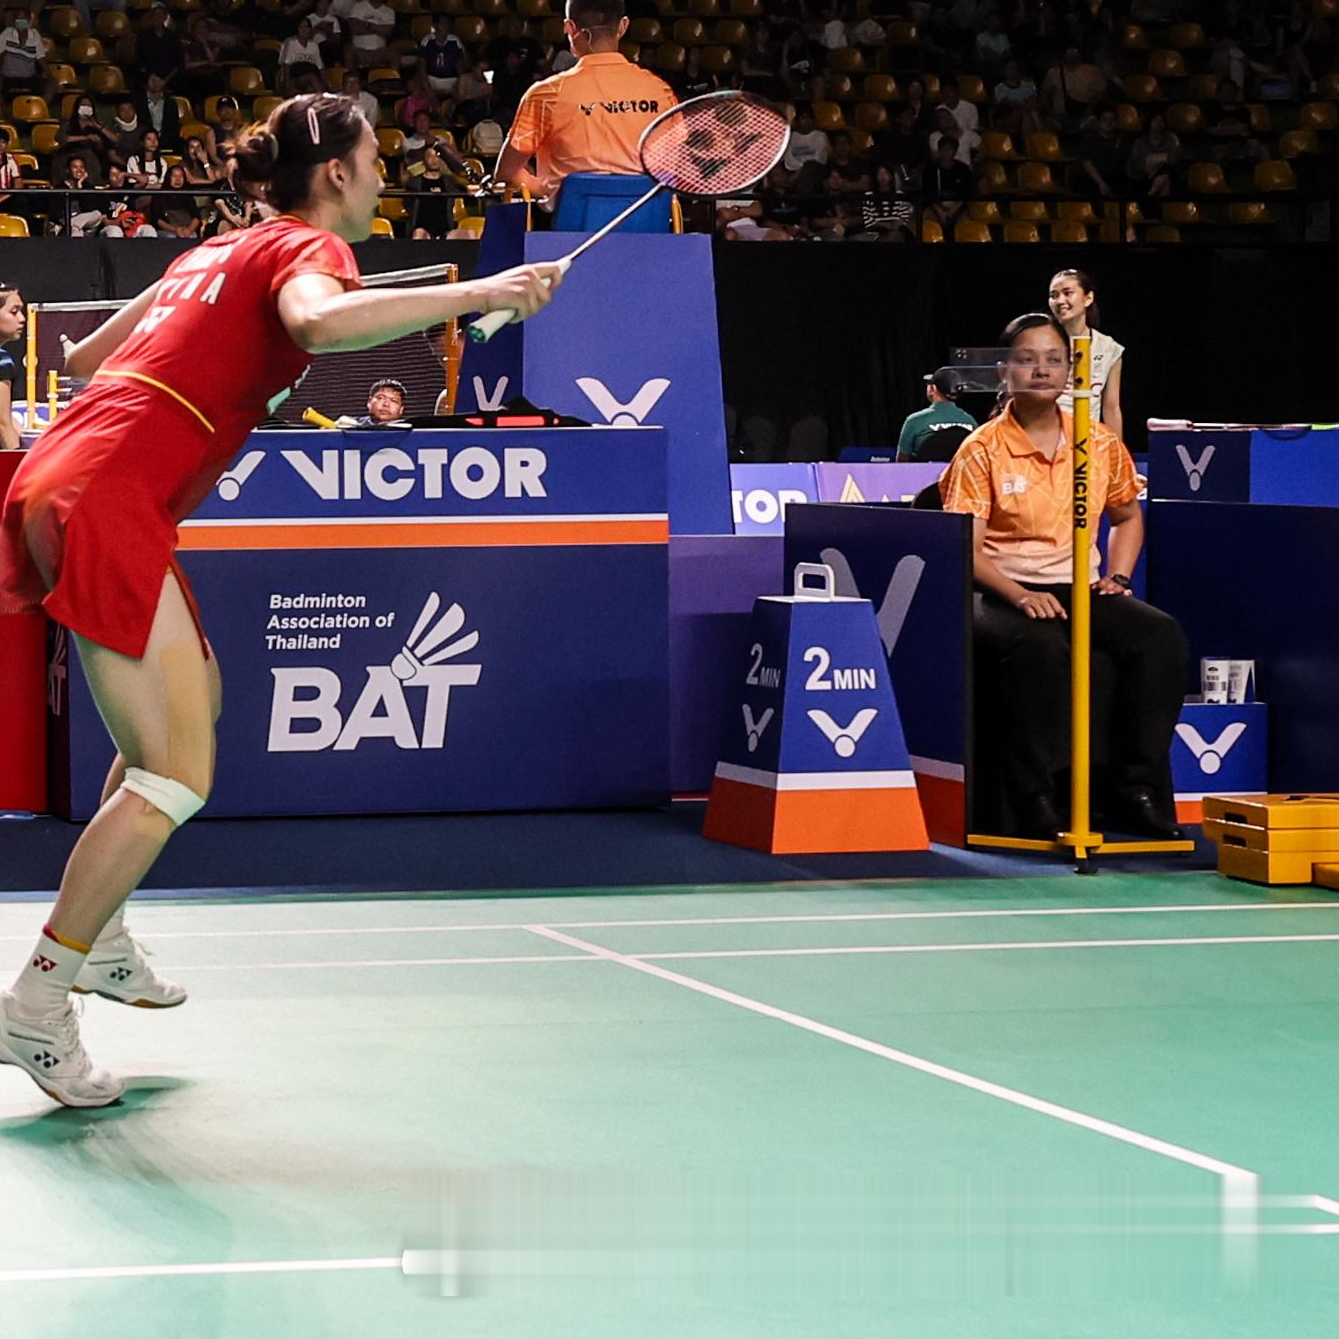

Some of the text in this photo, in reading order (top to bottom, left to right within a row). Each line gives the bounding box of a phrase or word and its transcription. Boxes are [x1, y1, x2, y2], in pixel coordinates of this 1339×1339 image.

[600, 100, 659, 114] VICTOR
[280, 447, 547, 500] VICTOR
[1074, 463, 1088, 529] VICTOR
[269, 593, 366, 609] Badminton
[267, 612, 395, 629] Association of
[265, 633, 341, 650] Thailand
[267, 664, 482, 751] BAT
